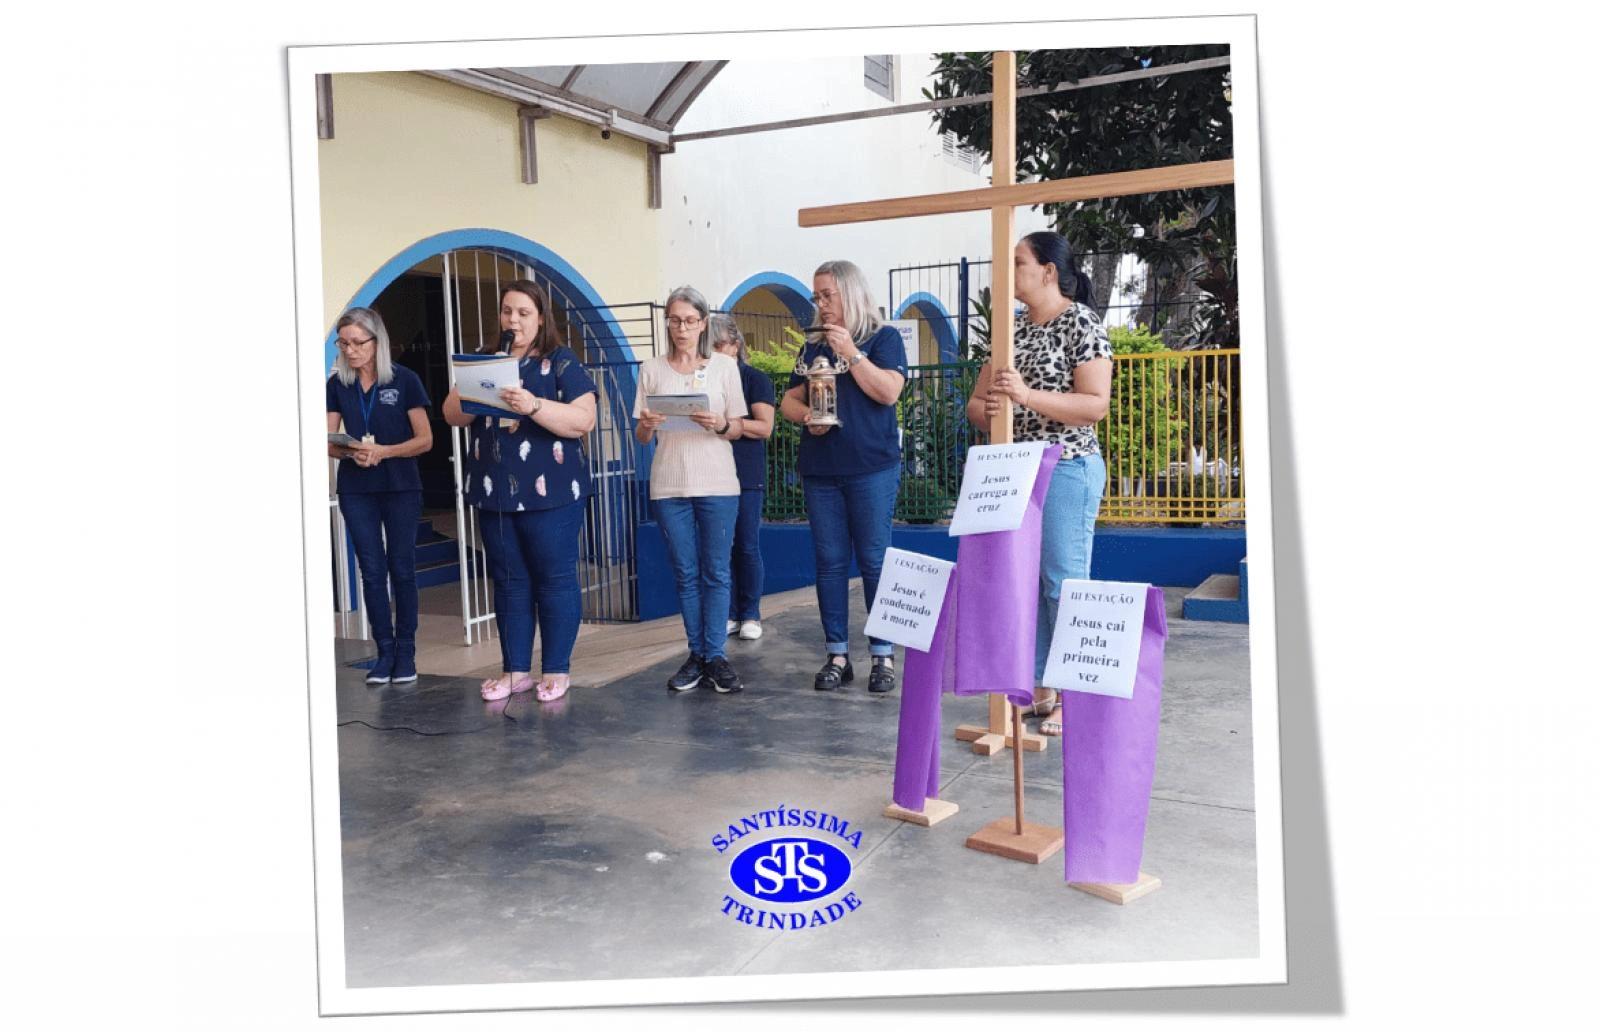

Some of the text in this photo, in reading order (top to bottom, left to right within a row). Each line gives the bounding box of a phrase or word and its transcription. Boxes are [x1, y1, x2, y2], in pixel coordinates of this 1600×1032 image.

[986, 450, 1030, 461] ESTAÇÃO
[981, 475, 1010, 484] Jesus
[968, 490, 1008, 501] carrega
[977, 504, 1000, 513] cruz
[900, 560, 939, 575] ESTAÇÃO
[891, 582, 926, 600] Jesus é
[1071, 592, 1134, 605] III ESTAÇÃO
[880, 597, 931, 617] condenado
[882, 611, 919, 629] à morte
[1069, 616, 1126, 633] Jesus cai
[1080, 635, 1107, 649] pela
[1062, 651, 1120, 668] primeira
[1078, 672, 1099, 684] vez
